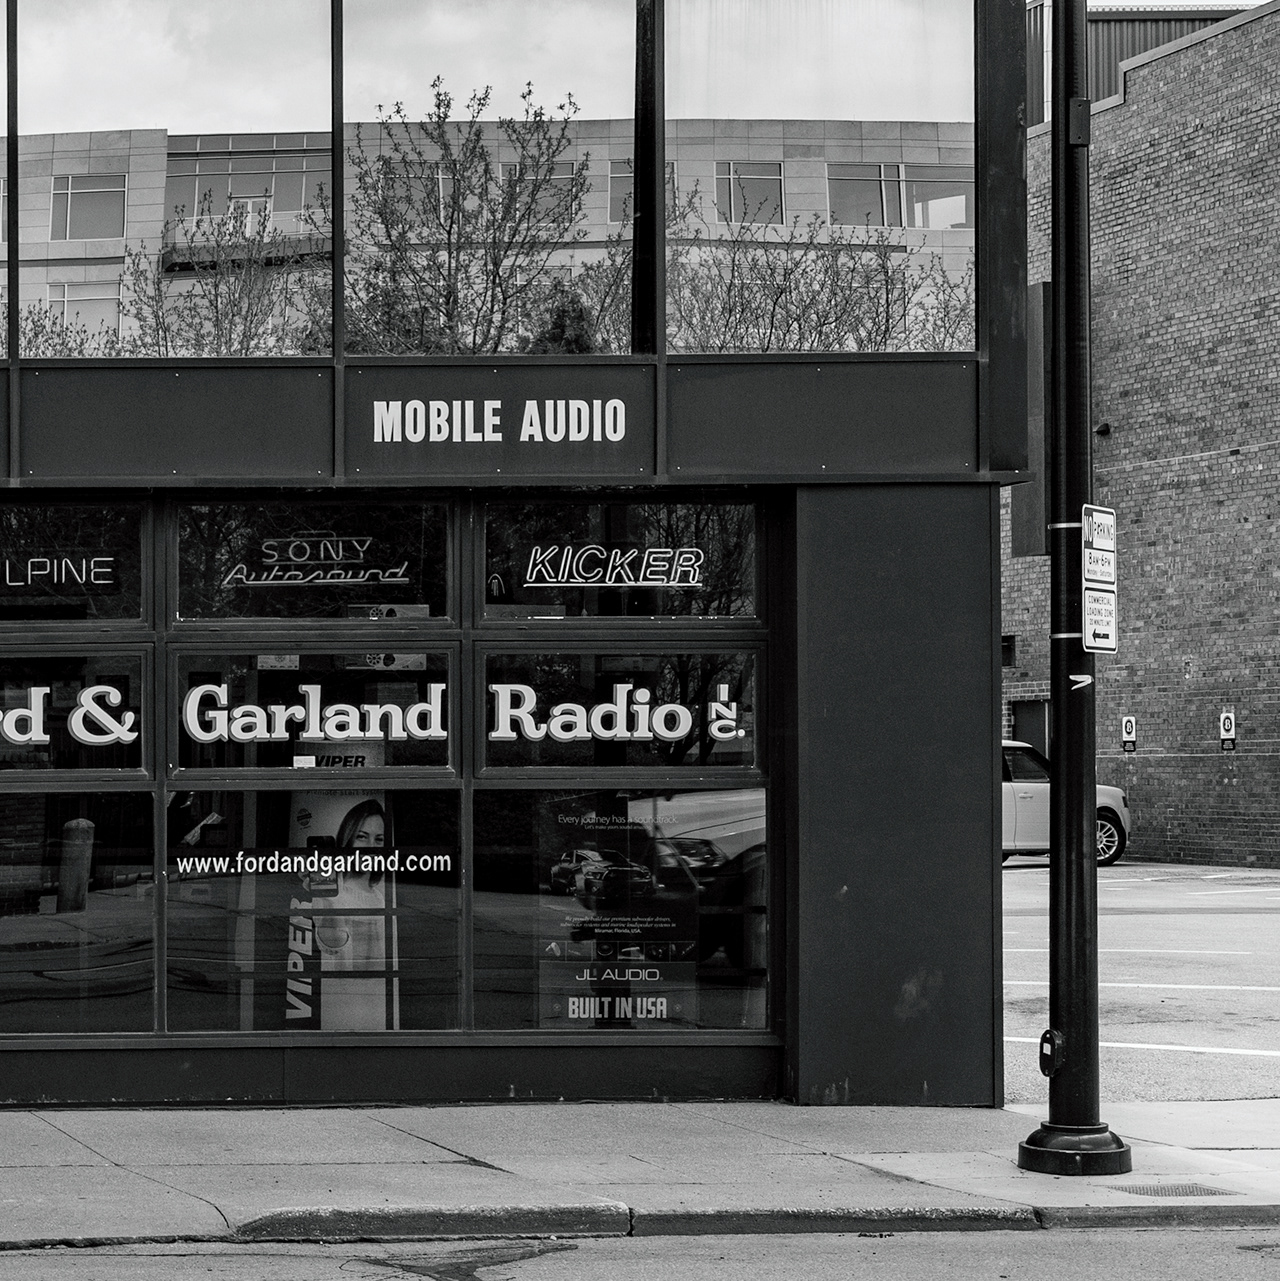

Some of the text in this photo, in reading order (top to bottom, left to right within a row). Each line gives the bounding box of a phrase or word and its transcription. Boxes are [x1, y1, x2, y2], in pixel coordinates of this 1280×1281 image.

[373, 399, 626, 443] MOBILE AUDIO
[1083, 515, 1113, 542] NO PARKING
[261, 540, 372, 563] SONY
[221, 561, 410, 586] Autosound
[526, 545, 704, 584] KICKER
[67, 685, 140, 746] &
[183, 683, 448, 743] Garland
[489, 683, 693, 742] Radio
[315, 755, 366, 767] VIPER
[557, 814, 580, 825] Every
[580, 814, 610, 825] journey
[612, 814, 627, 823] has
[177, 850, 452, 876] www.fordandgarland.com
[576, 969, 598, 980] JL
[568, 997, 667, 1019] BUILT IN USA
